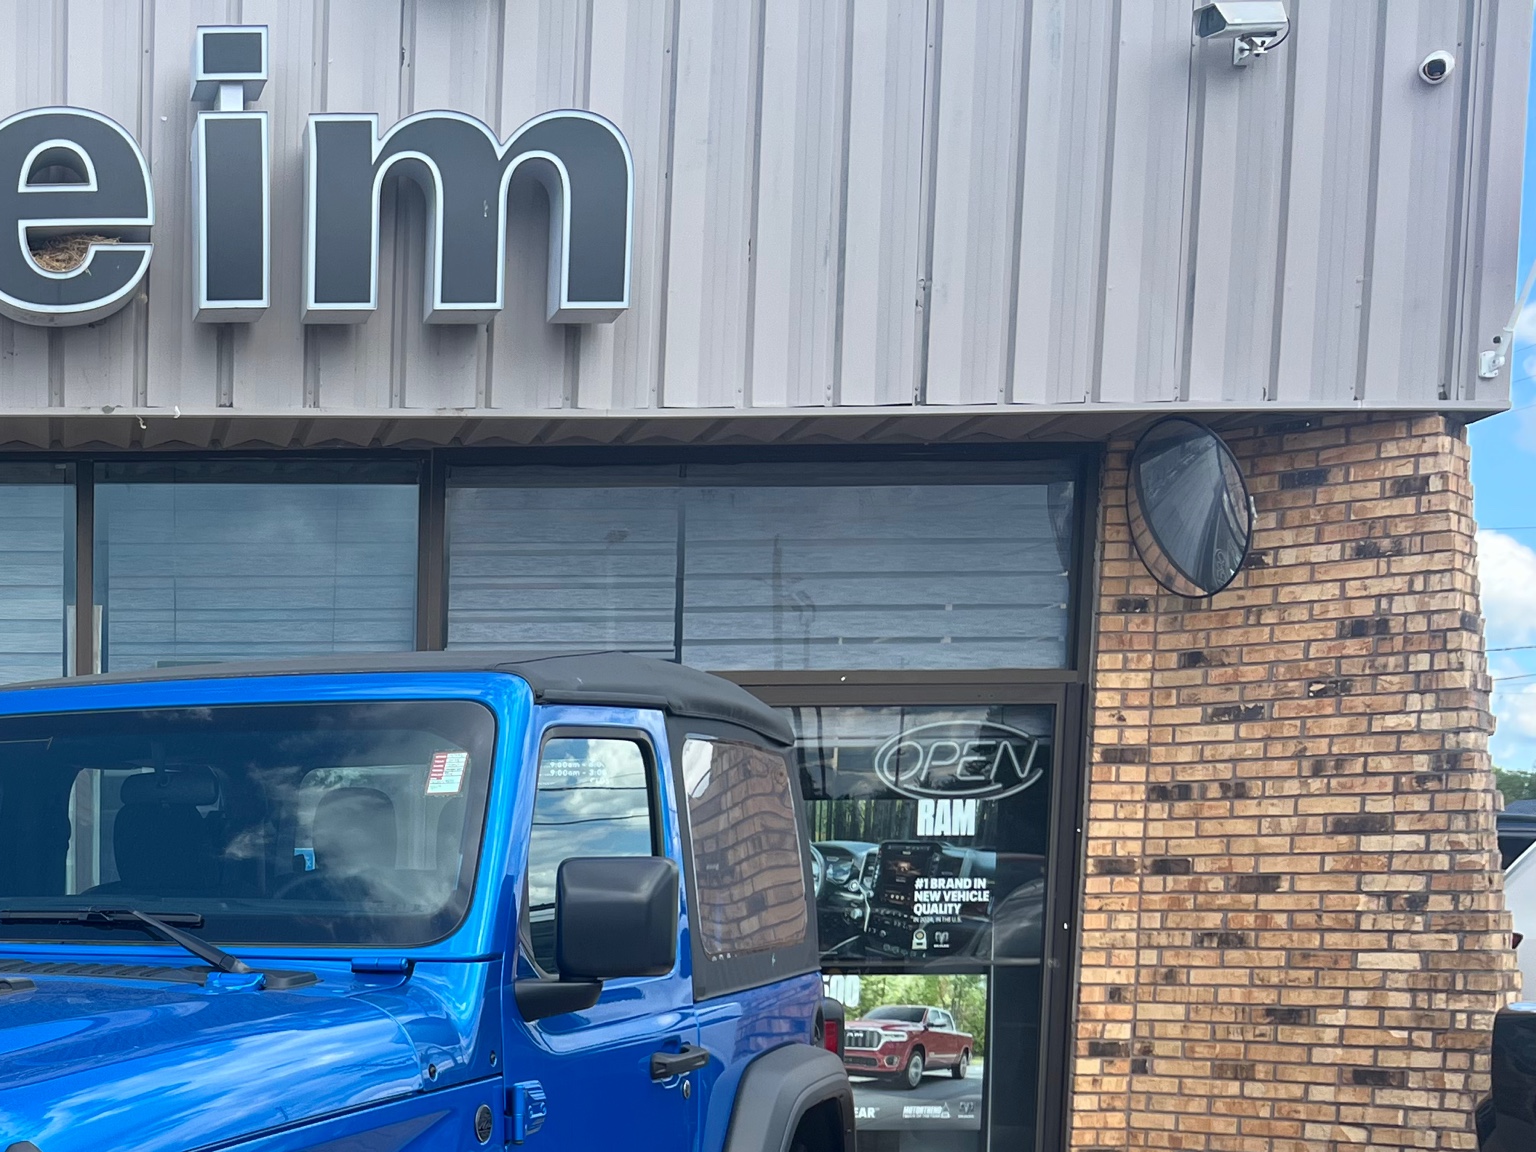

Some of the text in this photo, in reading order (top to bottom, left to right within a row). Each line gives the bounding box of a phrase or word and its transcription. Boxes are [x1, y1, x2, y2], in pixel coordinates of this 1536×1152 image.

[882, 740, 1039, 782] OPEN
[916, 798, 976, 837] RAM
[914, 877, 987, 890] #1 BRAND IN
[914, 890, 990, 902] NEW VEHICLE
[913, 902, 962, 917] QUALITY
